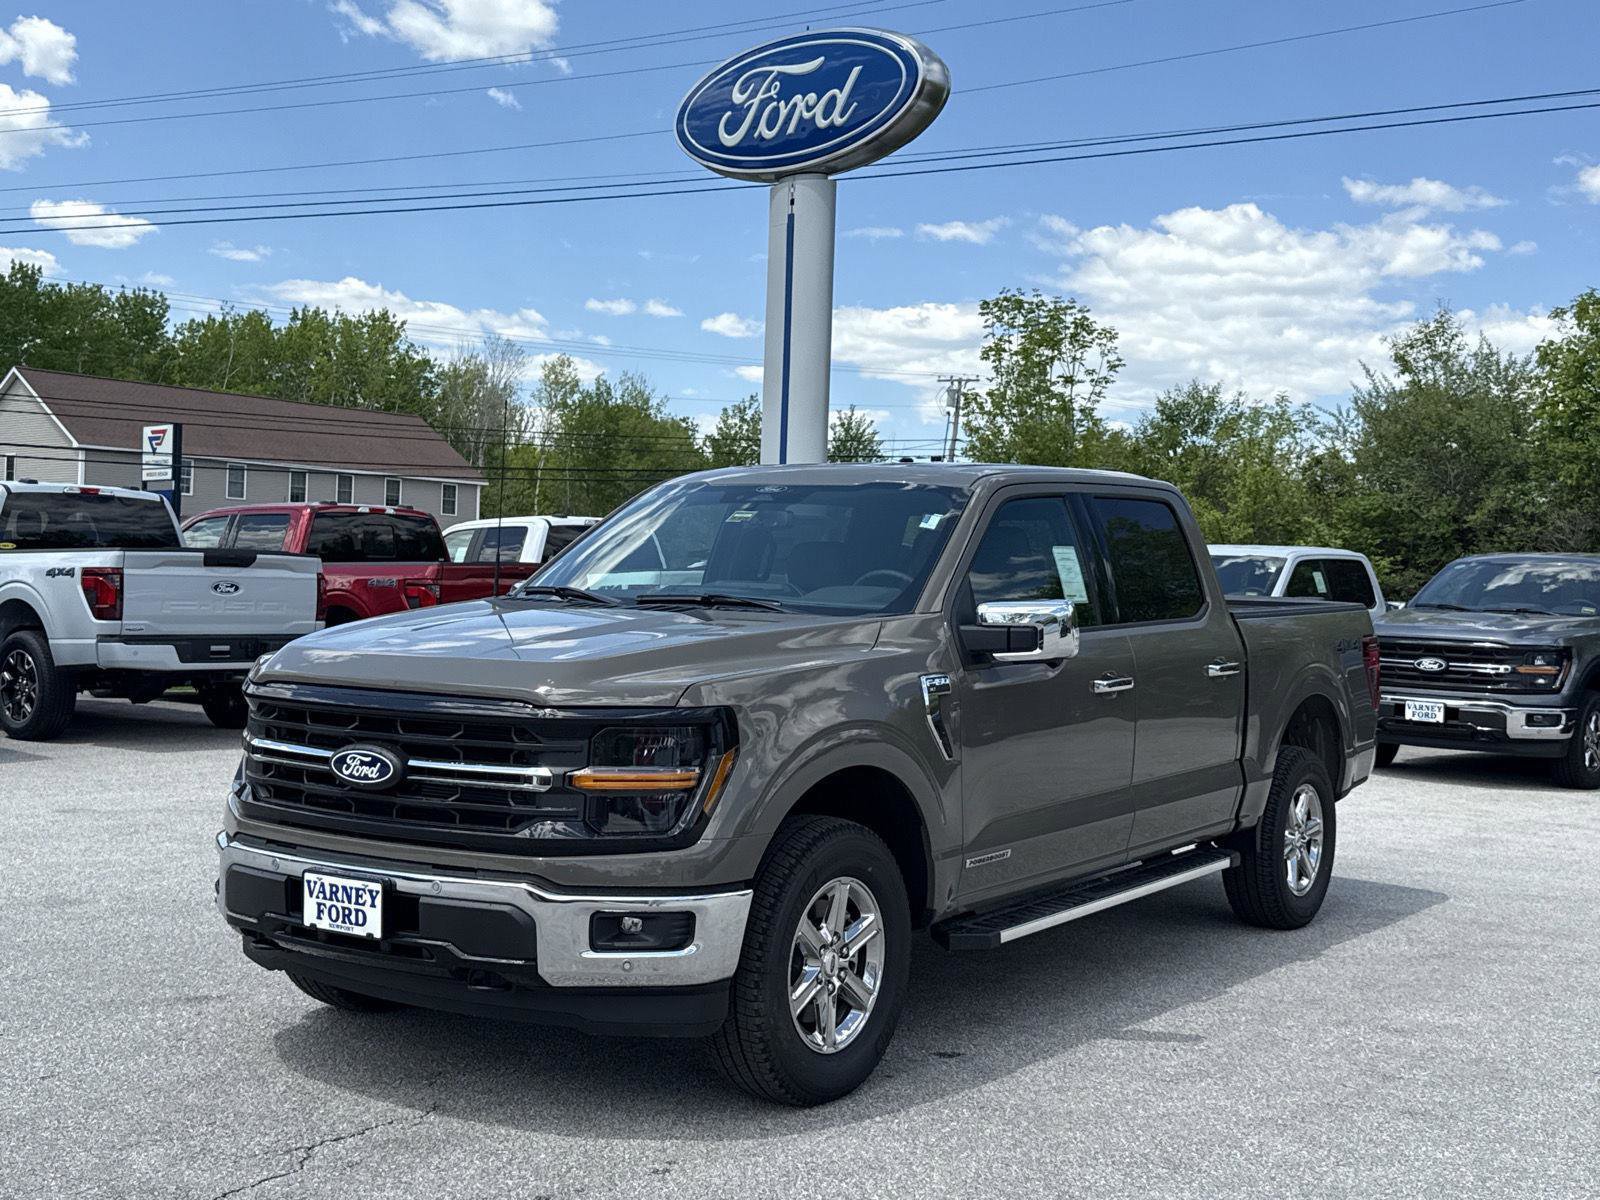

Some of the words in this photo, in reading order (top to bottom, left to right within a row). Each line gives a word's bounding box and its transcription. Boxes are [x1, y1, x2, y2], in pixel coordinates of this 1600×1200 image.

[718, 56, 864, 147] Ford
[216, 582, 236, 593] Ford
[1420, 660, 1440, 669] Ford
[1407, 703, 1443, 713] VARNEY
[1412, 711, 1437, 720] FORD
[342, 754, 381, 779] Ford
[305, 879, 380, 909] VARNEY
[316, 901, 367, 927] FORD
